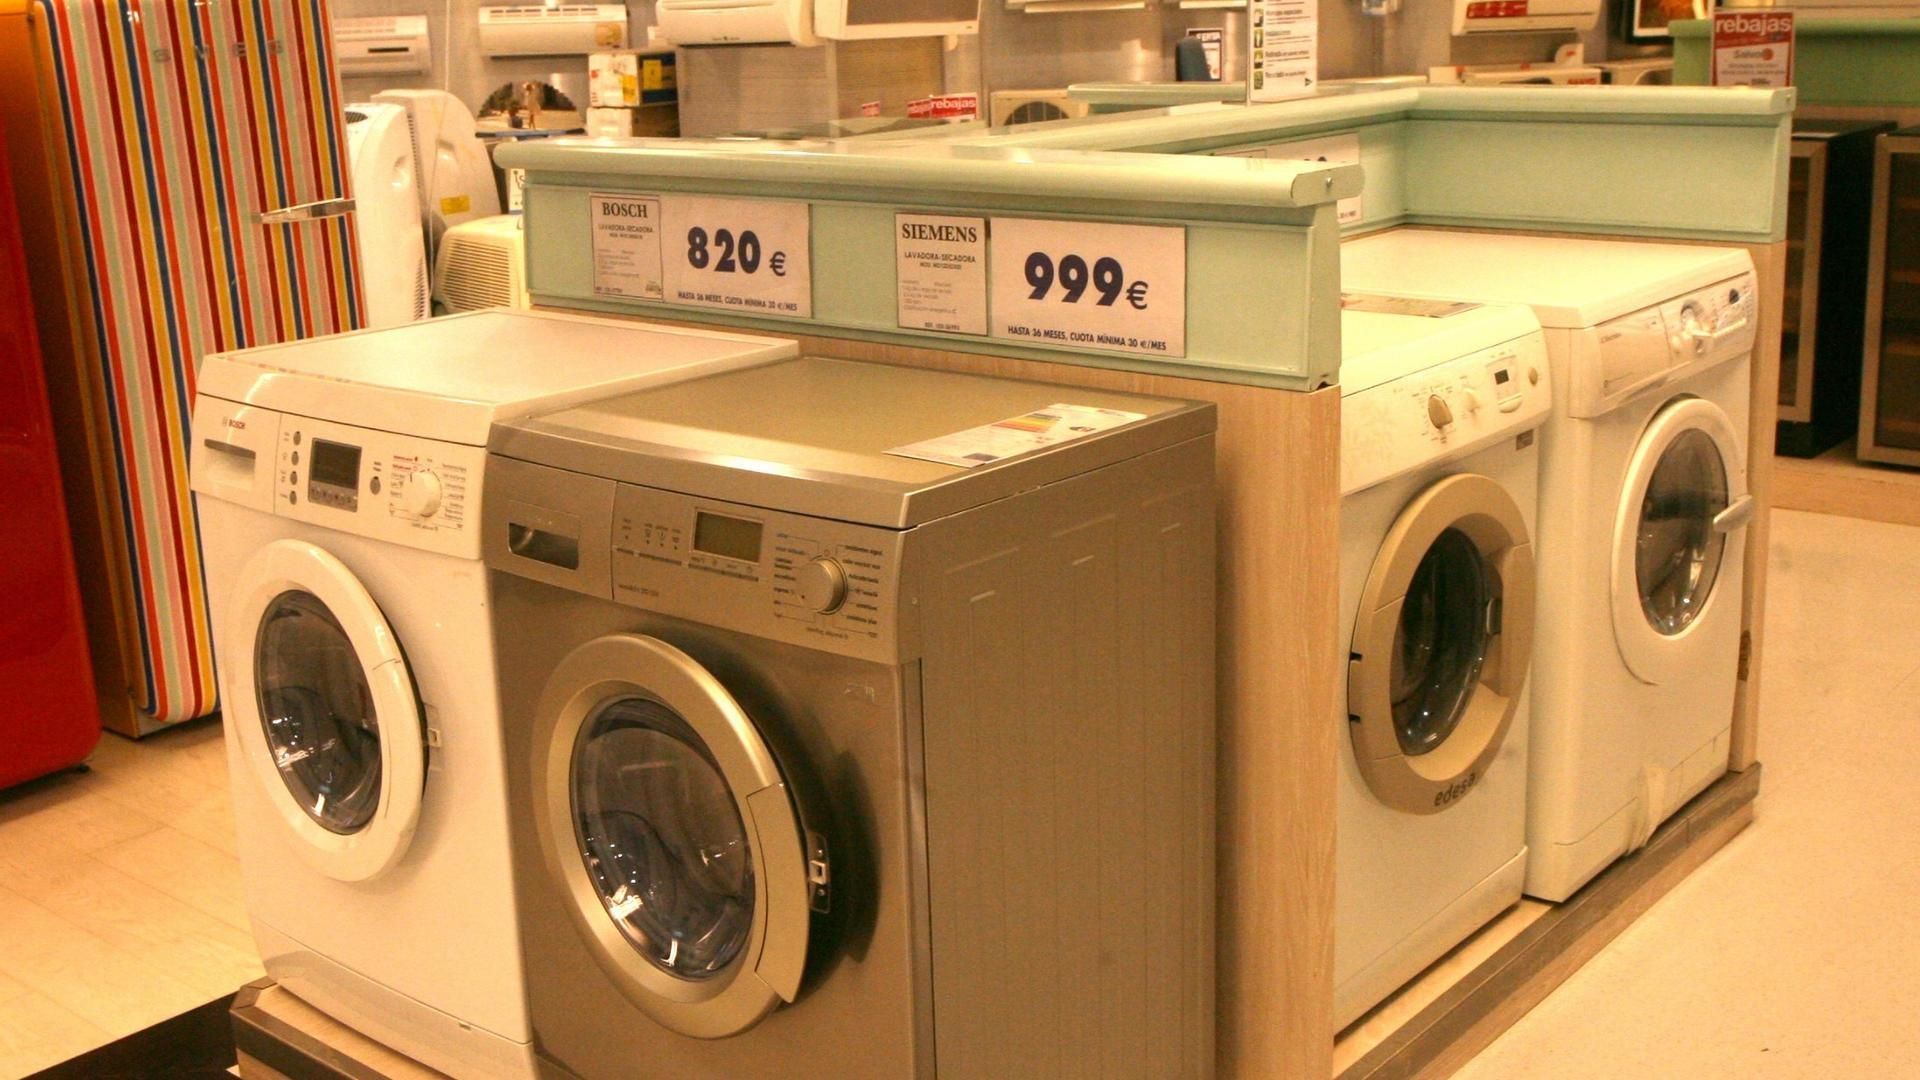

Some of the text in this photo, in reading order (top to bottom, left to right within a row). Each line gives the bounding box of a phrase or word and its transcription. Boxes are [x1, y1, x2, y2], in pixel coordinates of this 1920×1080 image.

[1716, 14, 1792, 36] rebajas
[930, 98, 976, 110] rebajas
[602, 202, 648, 218] BOSCH
[902, 223, 977, 243] SIEMENS
[687, 226, 787, 277] 820 €
[678, 291, 695, 300] HASTA
[725, 296, 743, 305] CUOTA
[1008, 325, 1030, 336] HASTA
[1032, 328, 1042, 337] 36
[1044, 329, 1068, 341] MESES,
[1070, 332, 1094, 343] CUOTA
[1128, 338, 1138, 348] 30
[1434, 772, 1476, 807] edesa
